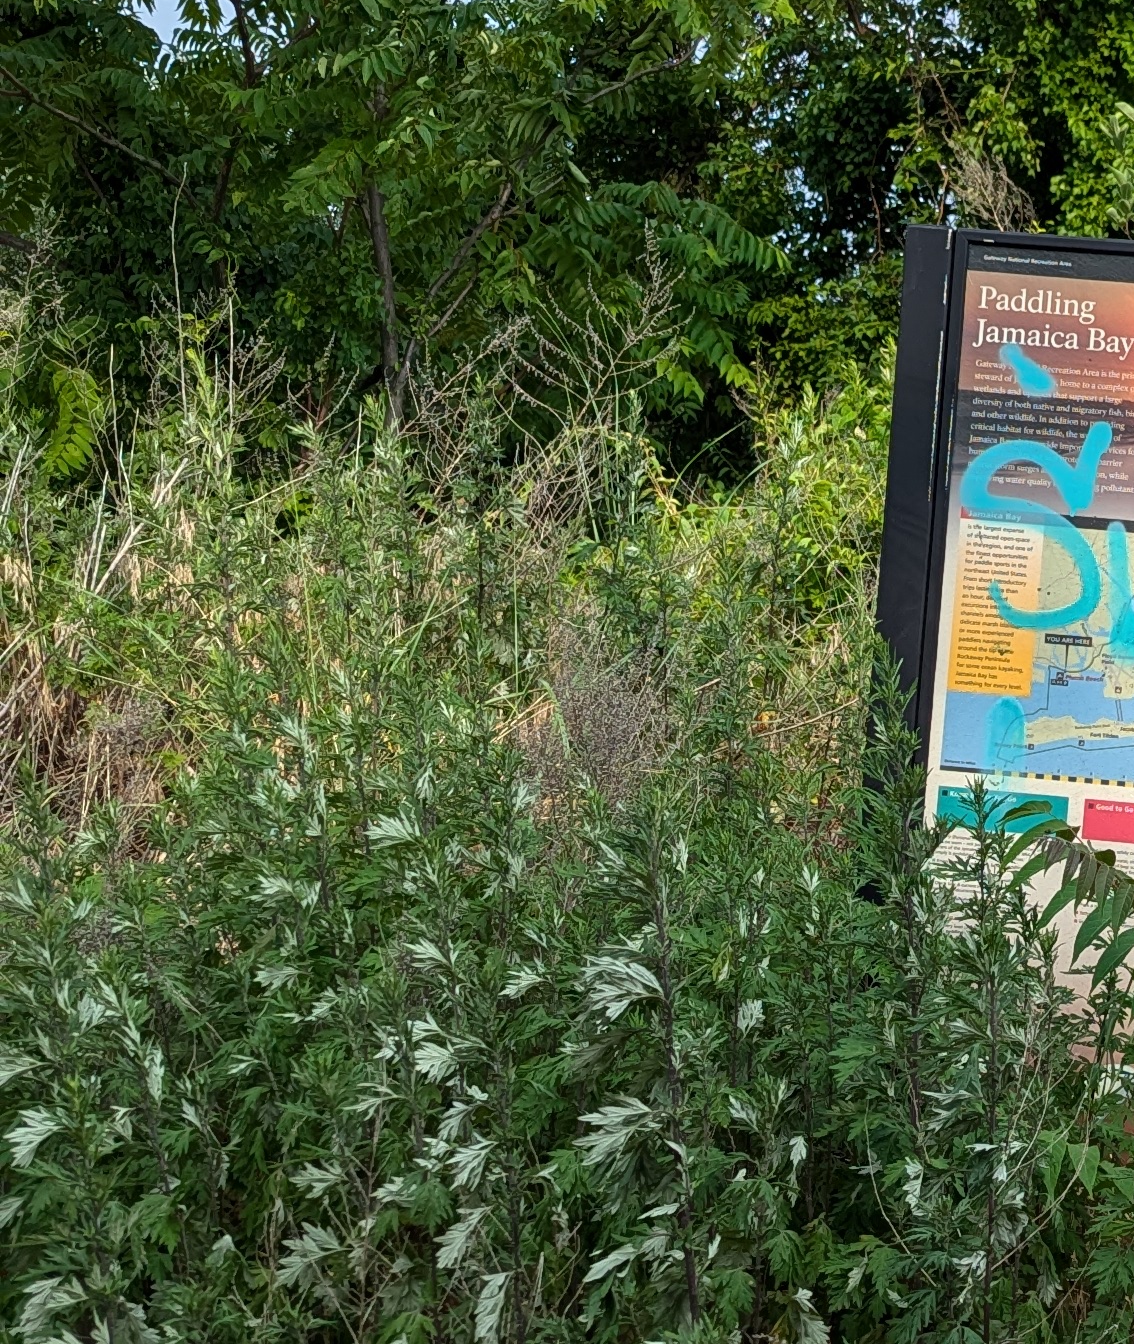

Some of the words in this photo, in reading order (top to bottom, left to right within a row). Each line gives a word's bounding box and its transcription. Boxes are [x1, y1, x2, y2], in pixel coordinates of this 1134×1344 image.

[978, 285, 1096, 324] Paddling
[972, 318, 1078, 350] Jamaica
[976, 360, 1006, 371] Gateway
[1042, 365, 1080, 375] Recreation
[1060, 379, 1080, 388] home
[1098, 384, 1128, 392] complex
[974, 385, 1005, 394] wetlands
[1069, 394, 1097, 403] support
[1105, 396, 1123, 405] large
[973, 397, 1003, 409] diversity
[1015, 401, 1031, 409] both
[1033, 403, 1054, 411] native
[1072, 406, 1107, 417] migratory
[1109, 408, 1124, 417] fish,
[987, 411, 1007, 419] other
[1009, 413, 1037, 422] wildlife.
[1049, 416, 1078, 425] addition
[971, 423, 995, 431] critical
[997, 424, 1021, 433] habitat
[1036, 427, 1064, 438] wildlife,
[969, 434, 997, 444] Jamaica
[1017, 465, 1039, 474] surges
[1109, 472, 1128, 480] while
[1027, 478, 1052, 487] quality
[968, 510, 1003, 520] Jamaica
[1006, 513, 1021, 522] Bay
